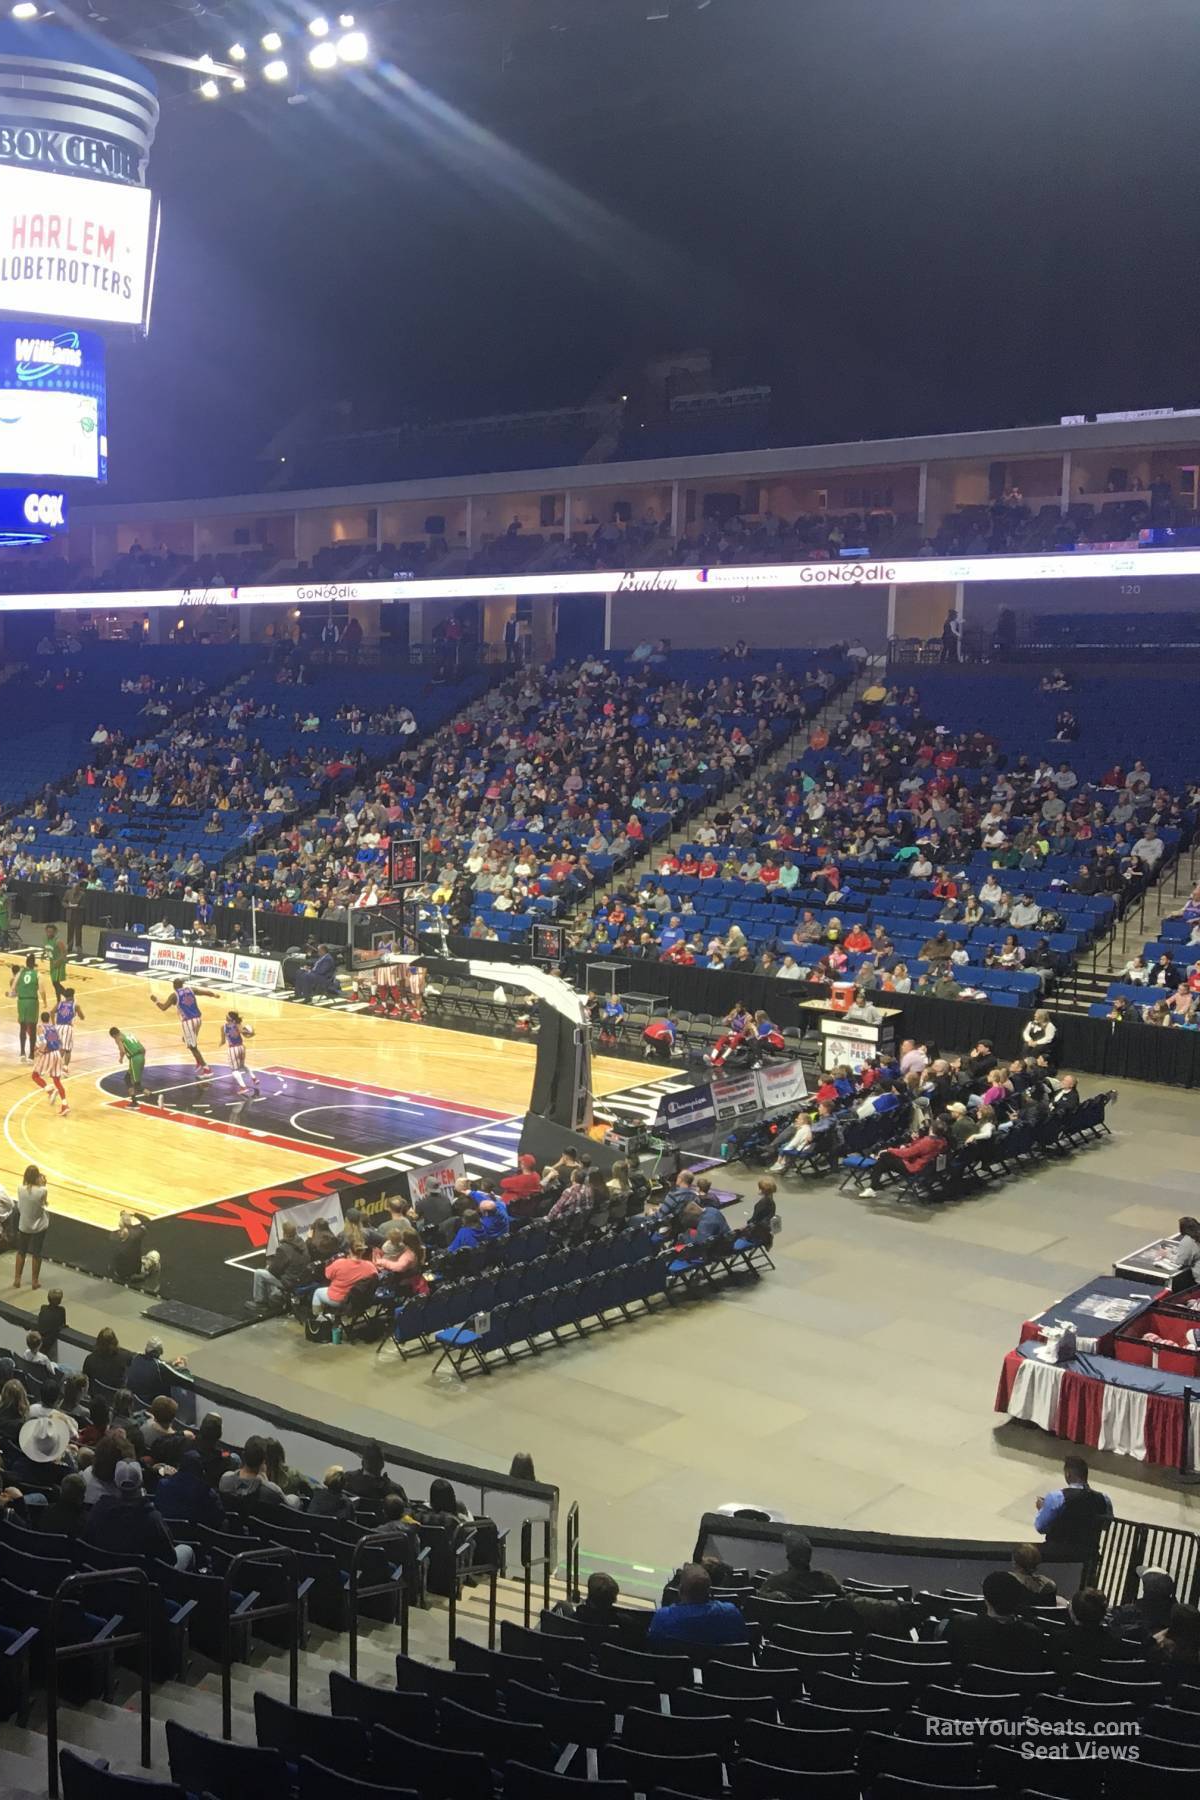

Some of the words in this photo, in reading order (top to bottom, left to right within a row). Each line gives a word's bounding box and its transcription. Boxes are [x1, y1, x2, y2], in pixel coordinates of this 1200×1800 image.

[12, 214, 116, 263] HARLEM
[15, 337, 82, 367] Williams
[24, 493, 65, 526] COX
[800, 563, 896, 585] GoNoodle
[297, 584, 359, 601] GoNoodle
[1120, 585, 1141, 595] 120
[730, 594, 746, 604] 121
[158, 949, 186, 961] HARLEM
[151, 959, 190, 972] GLOBETROTTERS
[200, 956, 229, 969] HARLEM
[193, 966, 232, 979] GLOBETROTTERS
[23, 974, 32, 985] 0
[668, 1096, 708, 1113] Champion
